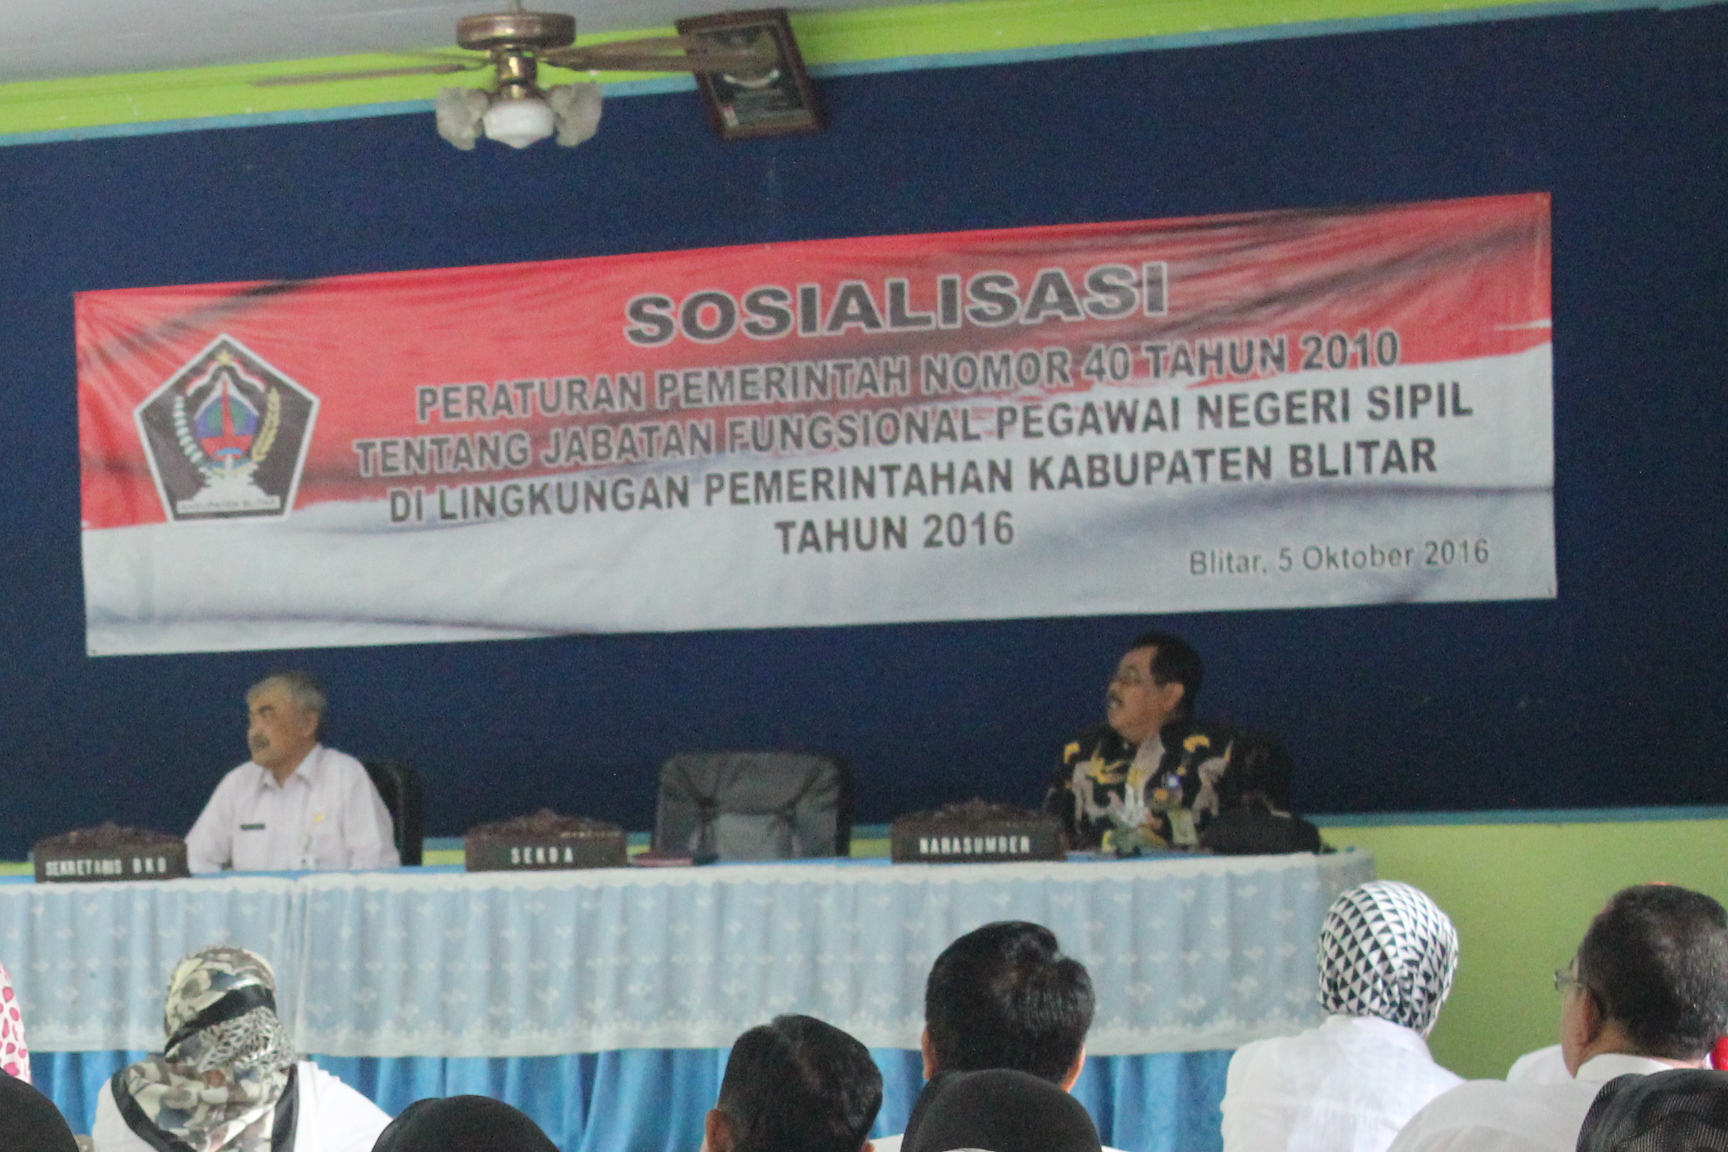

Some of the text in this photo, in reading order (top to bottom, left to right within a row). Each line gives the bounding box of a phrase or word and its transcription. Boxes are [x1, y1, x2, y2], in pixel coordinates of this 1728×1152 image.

[626, 264, 1167, 345] SOSIALISASI
[417, 330, 1400, 423] PERATURAN PEMERINTAH NOMOR 40 TAHUN 2010
[355, 381, 1474, 476] TENTANG JABATAN FUNGSIONAL PEGAWAI NEGERI SIPIL
[390, 437, 1438, 523] DI LINGKUNGAN PEMERINTAHAN KABUPATEN BLITAR
[775, 510, 1015, 555] TAHUN 2016
[1189, 538, 1490, 576] Blitar, 5 Oktober 2016
